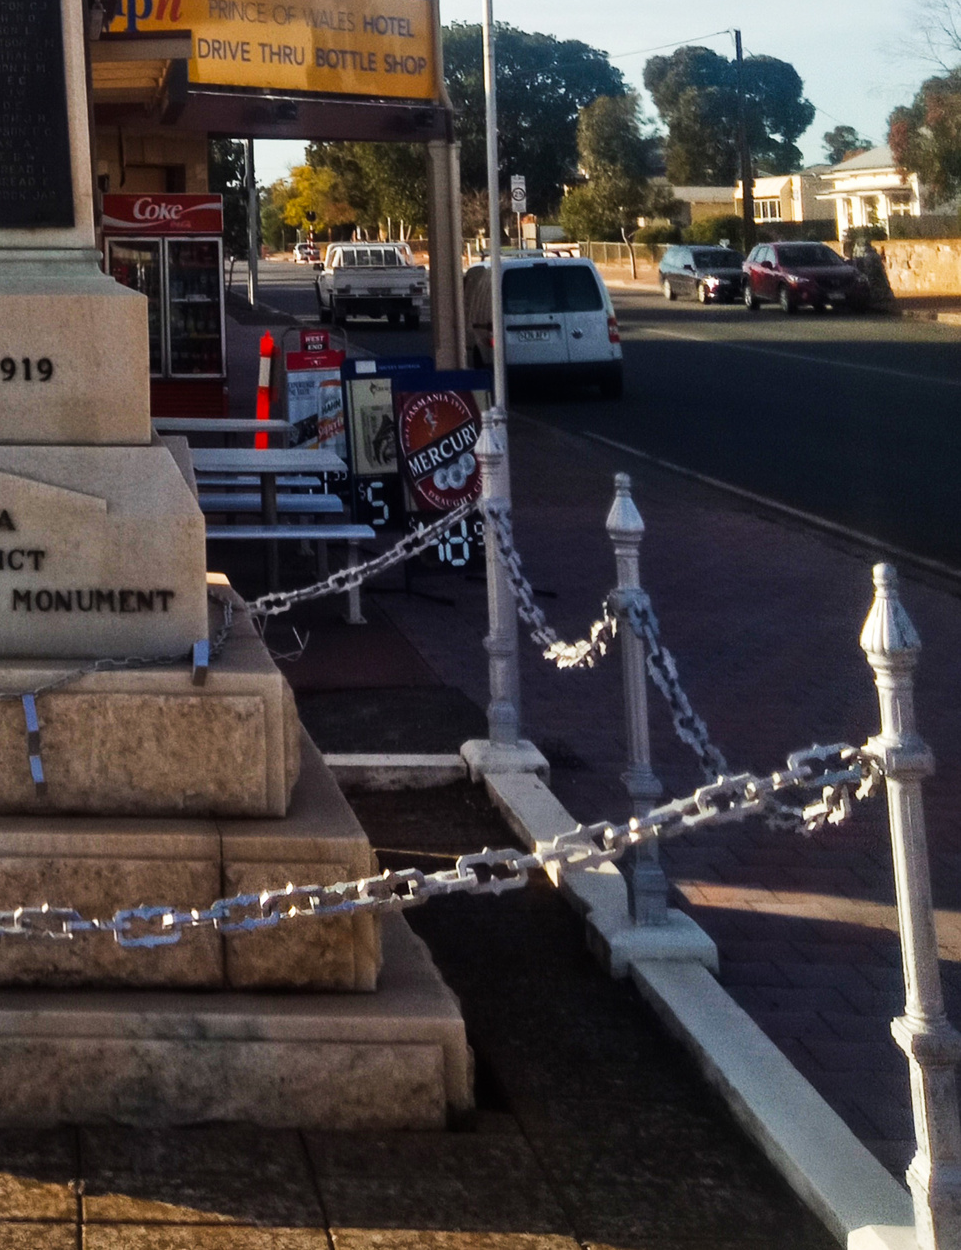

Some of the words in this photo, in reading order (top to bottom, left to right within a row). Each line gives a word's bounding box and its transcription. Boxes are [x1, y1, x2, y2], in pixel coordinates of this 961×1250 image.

[272, 4, 295, 26] OF
[304, 7, 356, 33] WALES
[363, 14, 415, 38] HOTEL
[198, 37, 251, 62] DRIVE
[258, 42, 305, 66] THRU
[315, 47, 378, 72] BOTTLE
[384, 53, 427, 75] SHOP
[133, 197, 183, 219] Coke
[304, 335, 325, 343] WEST
[405, 393, 449, 423] TASMANIA
[408, 421, 479, 477] MERCURY
[428, 489, 473, 508] DRAUGHT
[12, 589, 176, 613] MONUMENT
